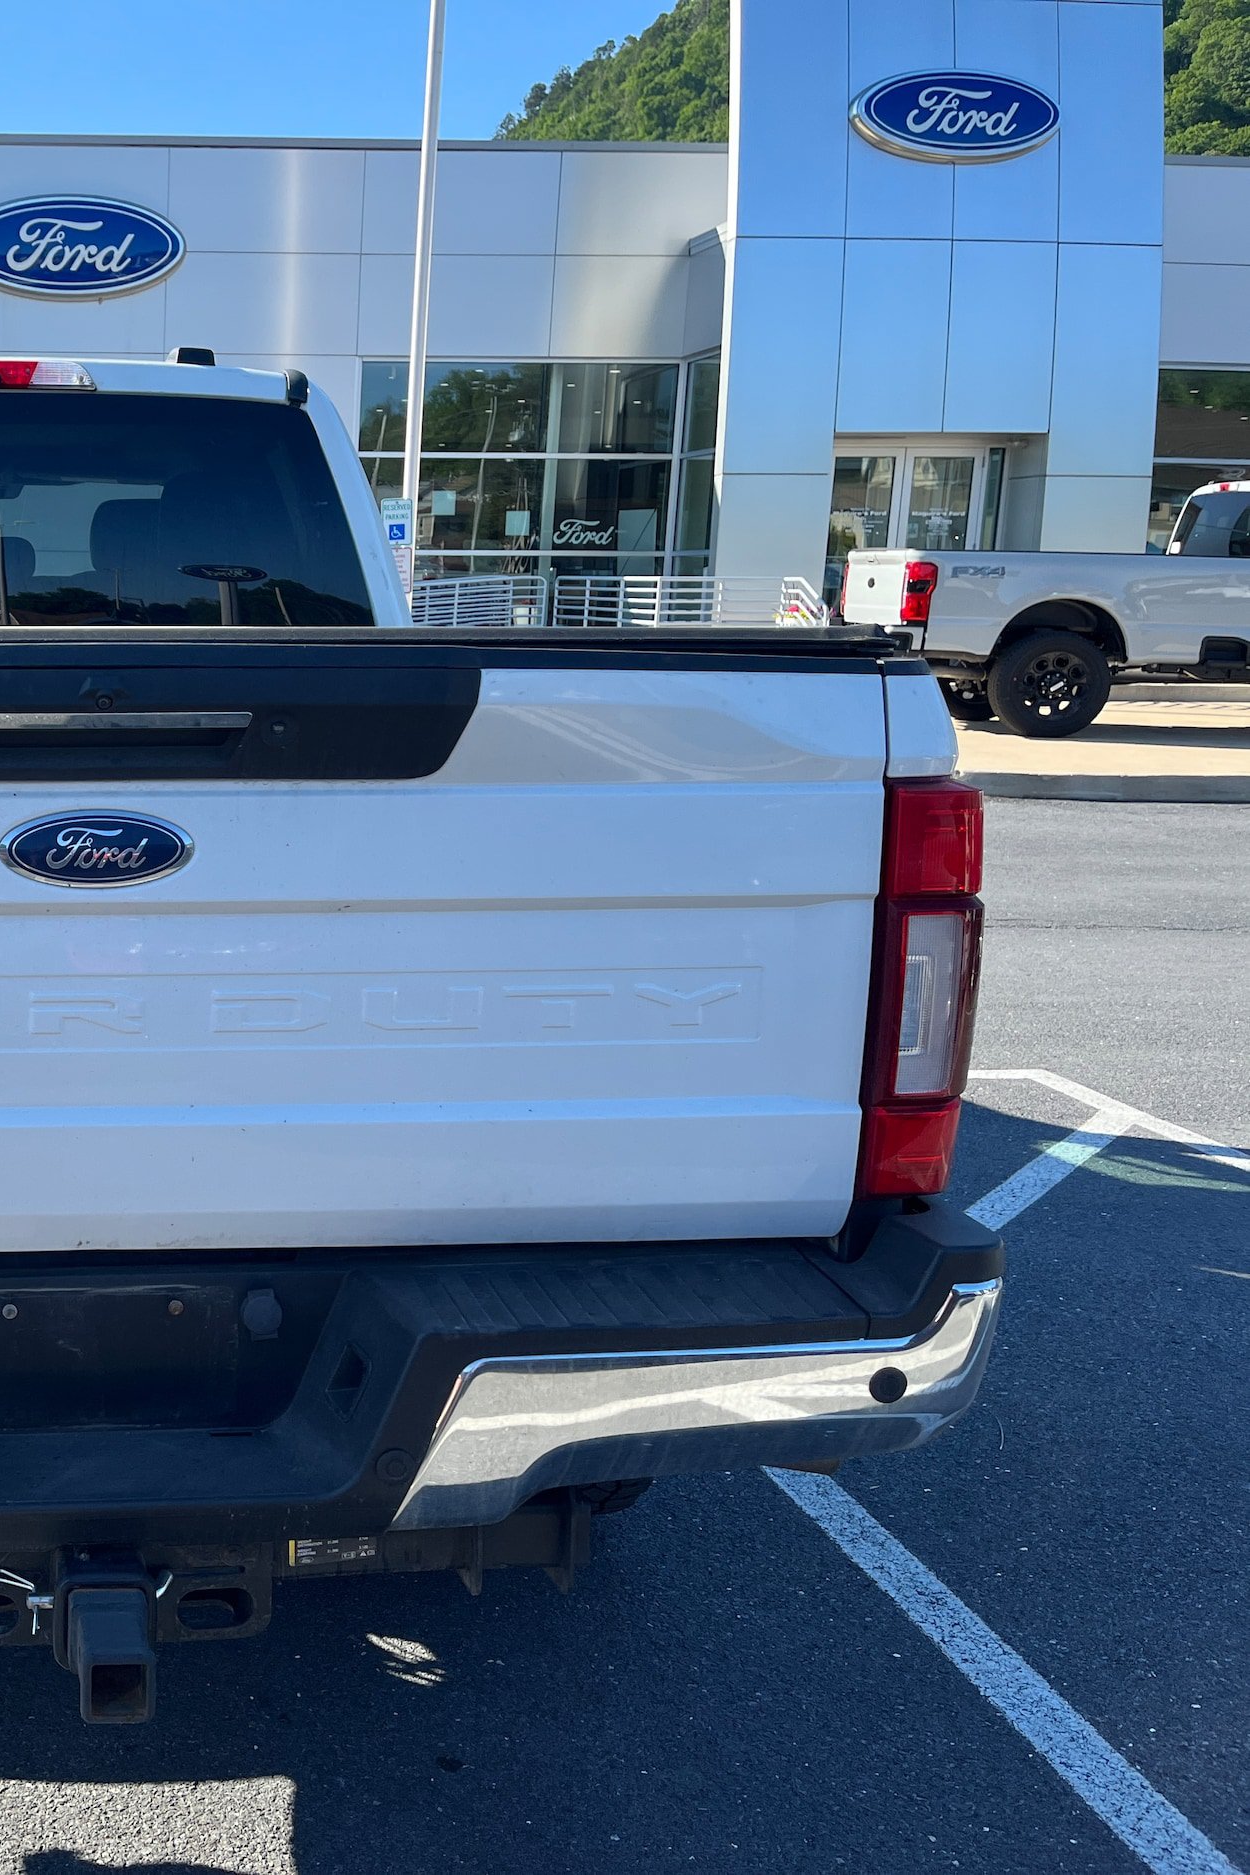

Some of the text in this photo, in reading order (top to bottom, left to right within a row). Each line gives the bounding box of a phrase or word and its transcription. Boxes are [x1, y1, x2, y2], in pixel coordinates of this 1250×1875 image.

[906, 86, 1021, 136] Ford
[6, 217, 135, 272] Ford
[383, 503, 411, 511] RESERVED
[553, 519, 615, 545] Ford
[951, 566, 1006, 579] FX4
[46, 827, 149, 869] Ford
[210, 982, 742, 1034] DUTY
